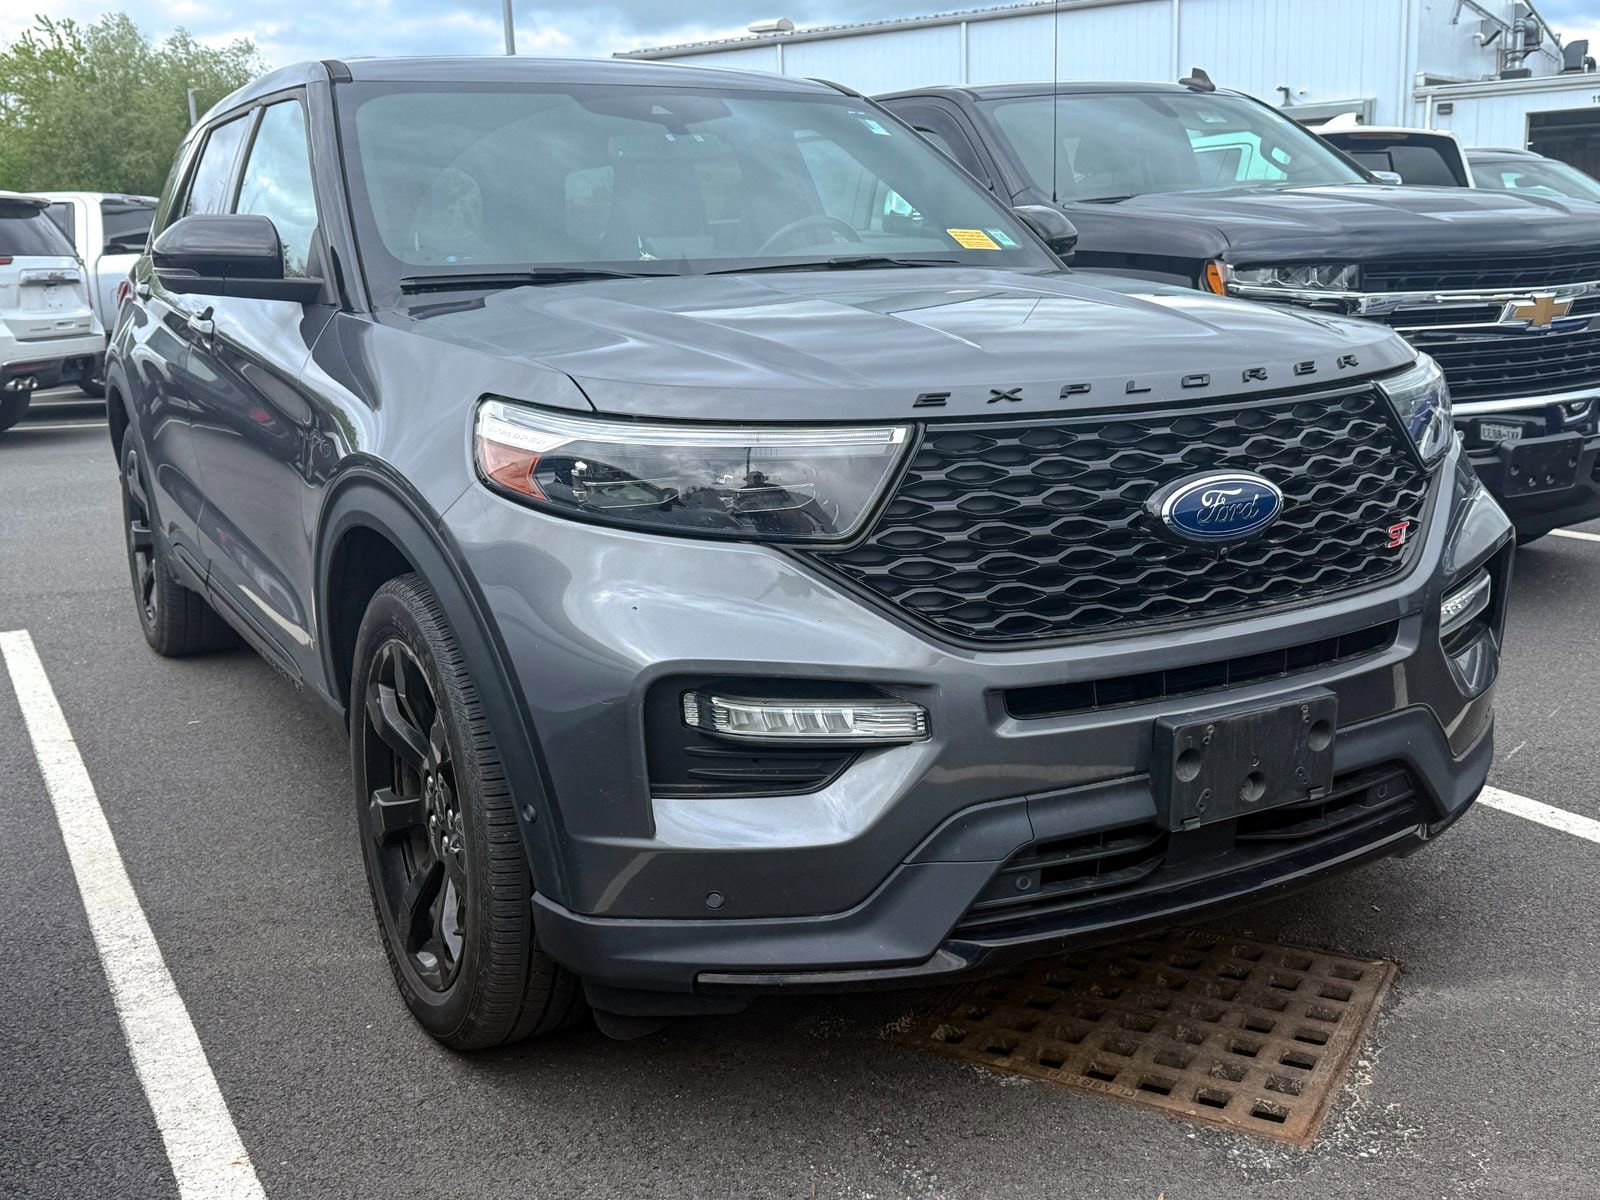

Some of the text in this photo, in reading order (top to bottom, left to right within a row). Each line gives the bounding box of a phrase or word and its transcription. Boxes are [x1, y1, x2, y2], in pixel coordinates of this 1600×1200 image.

[912, 353, 1360, 408] EXPLORER
[1196, 487, 1260, 526] Ford
[1387, 521, 1410, 549] ST
